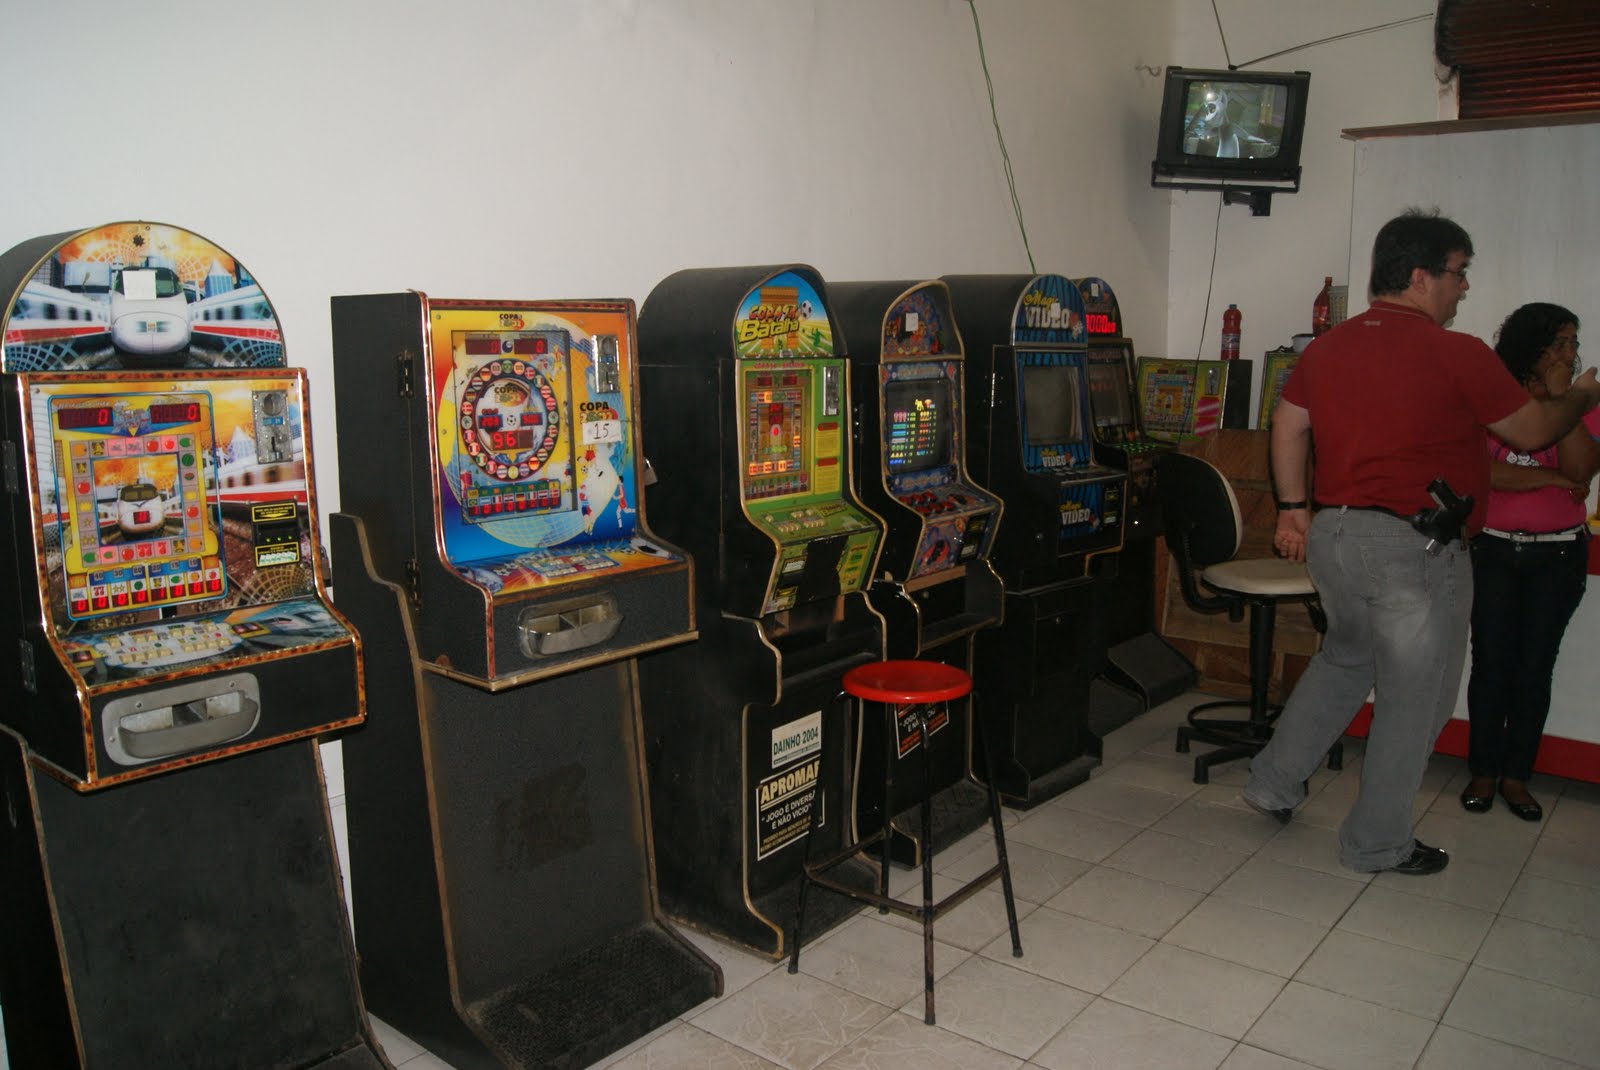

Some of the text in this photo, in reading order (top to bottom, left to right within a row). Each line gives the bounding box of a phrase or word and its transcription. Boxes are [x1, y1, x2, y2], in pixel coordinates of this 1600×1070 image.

[739, 319, 800, 343] Batalha
[494, 386, 518, 394] COPA
[187, 404, 197, 420] 0
[580, 401, 609, 411] COPA
[98, 408, 109, 425] 0
[593, 422, 610, 440] 15
[492, 431, 516, 449] 96
[1061, 508, 1091, 526] VIDEO
[773, 733, 800, 756] DAINHO
[802, 726, 819, 744] 2004
[771, 820, 777, 830] E
[777, 813, 791, 827] NÃO
